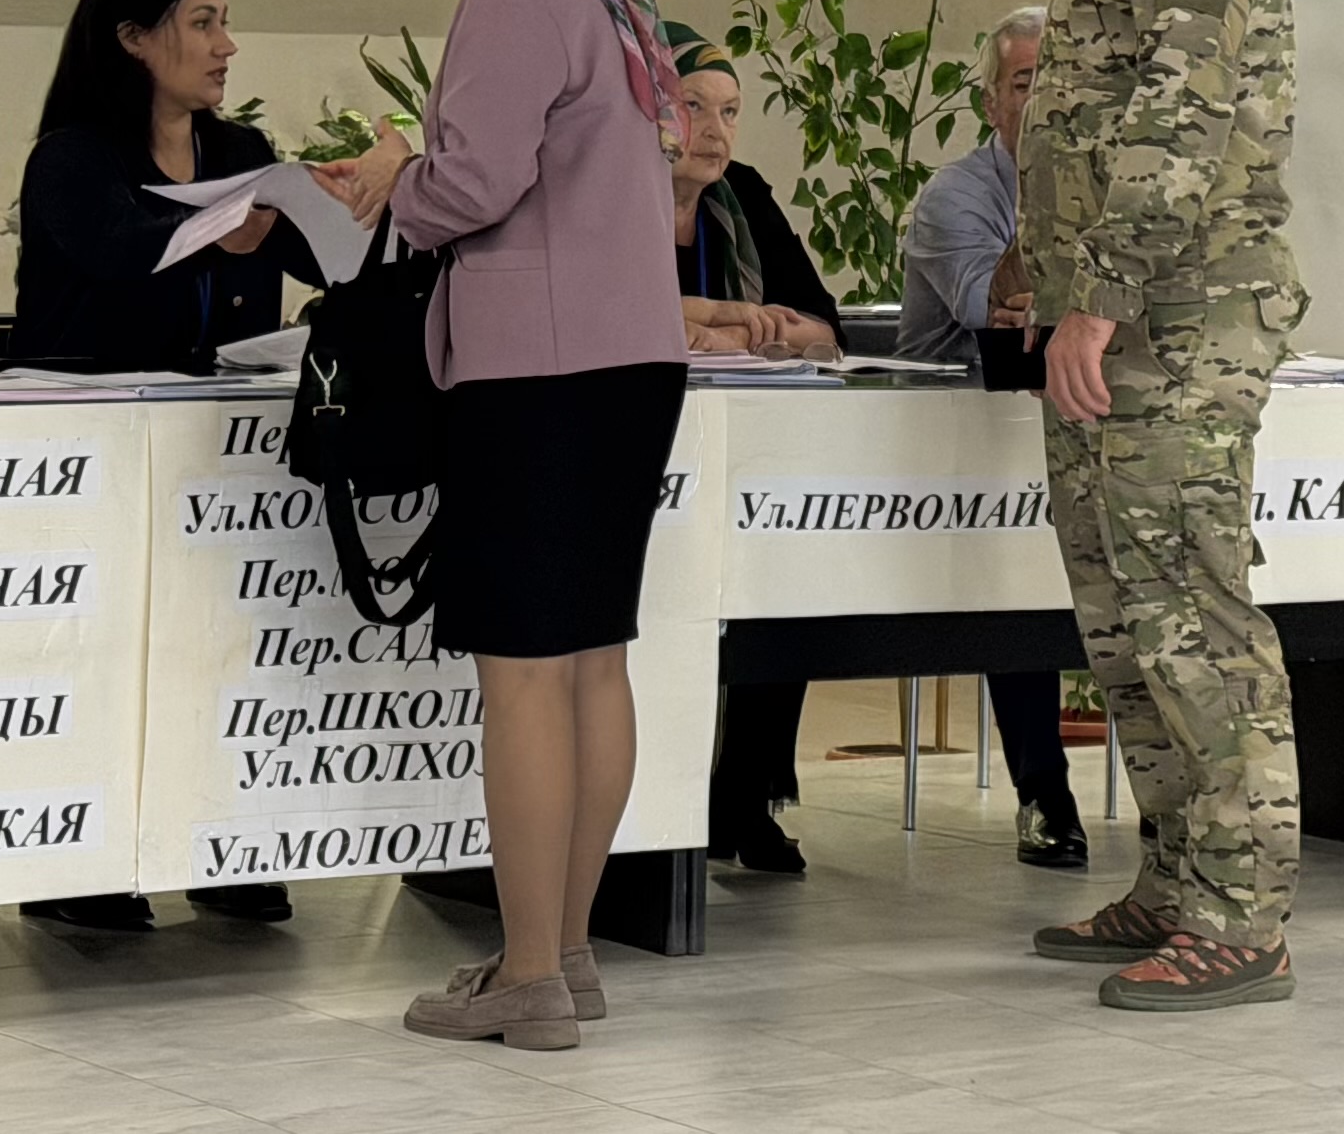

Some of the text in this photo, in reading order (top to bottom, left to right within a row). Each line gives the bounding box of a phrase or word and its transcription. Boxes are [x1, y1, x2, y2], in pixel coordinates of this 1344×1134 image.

[254, 623, 469, 676] Пер.САД
[239, 739, 484, 790] Ул.КОЛХО
[205, 817, 492, 878] Ул.МОЛОДЕ
